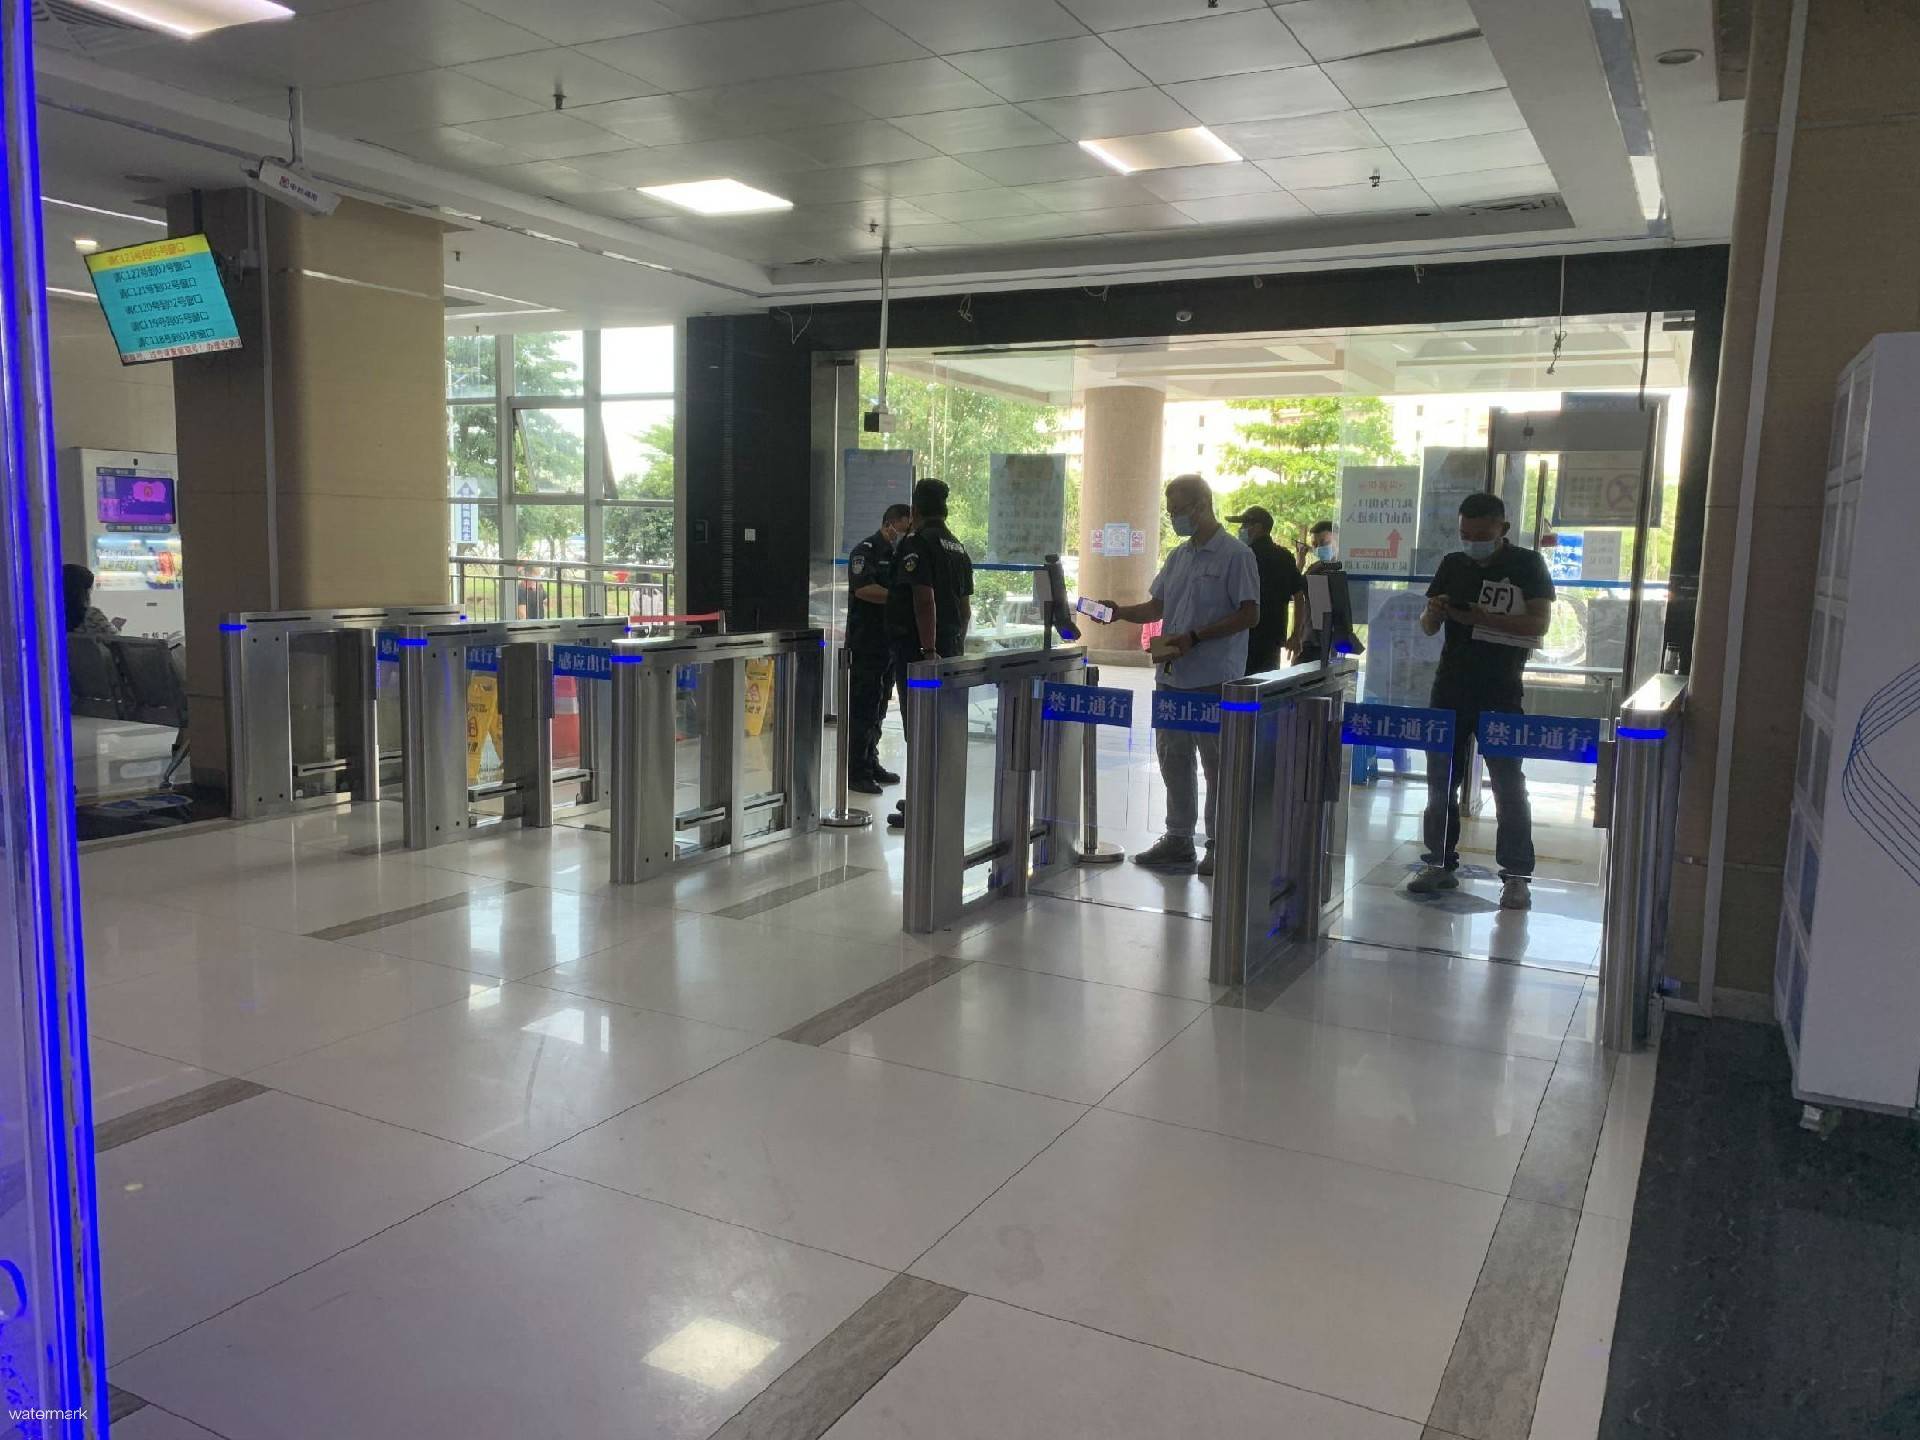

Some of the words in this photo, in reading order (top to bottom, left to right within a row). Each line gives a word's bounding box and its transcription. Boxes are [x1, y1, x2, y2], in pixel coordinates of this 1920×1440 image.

[1047, 690, 1128, 719] 禁止通行
[1349, 711, 1448, 743] 禁止通行
[1484, 720, 1592, 752] 禁止通行
